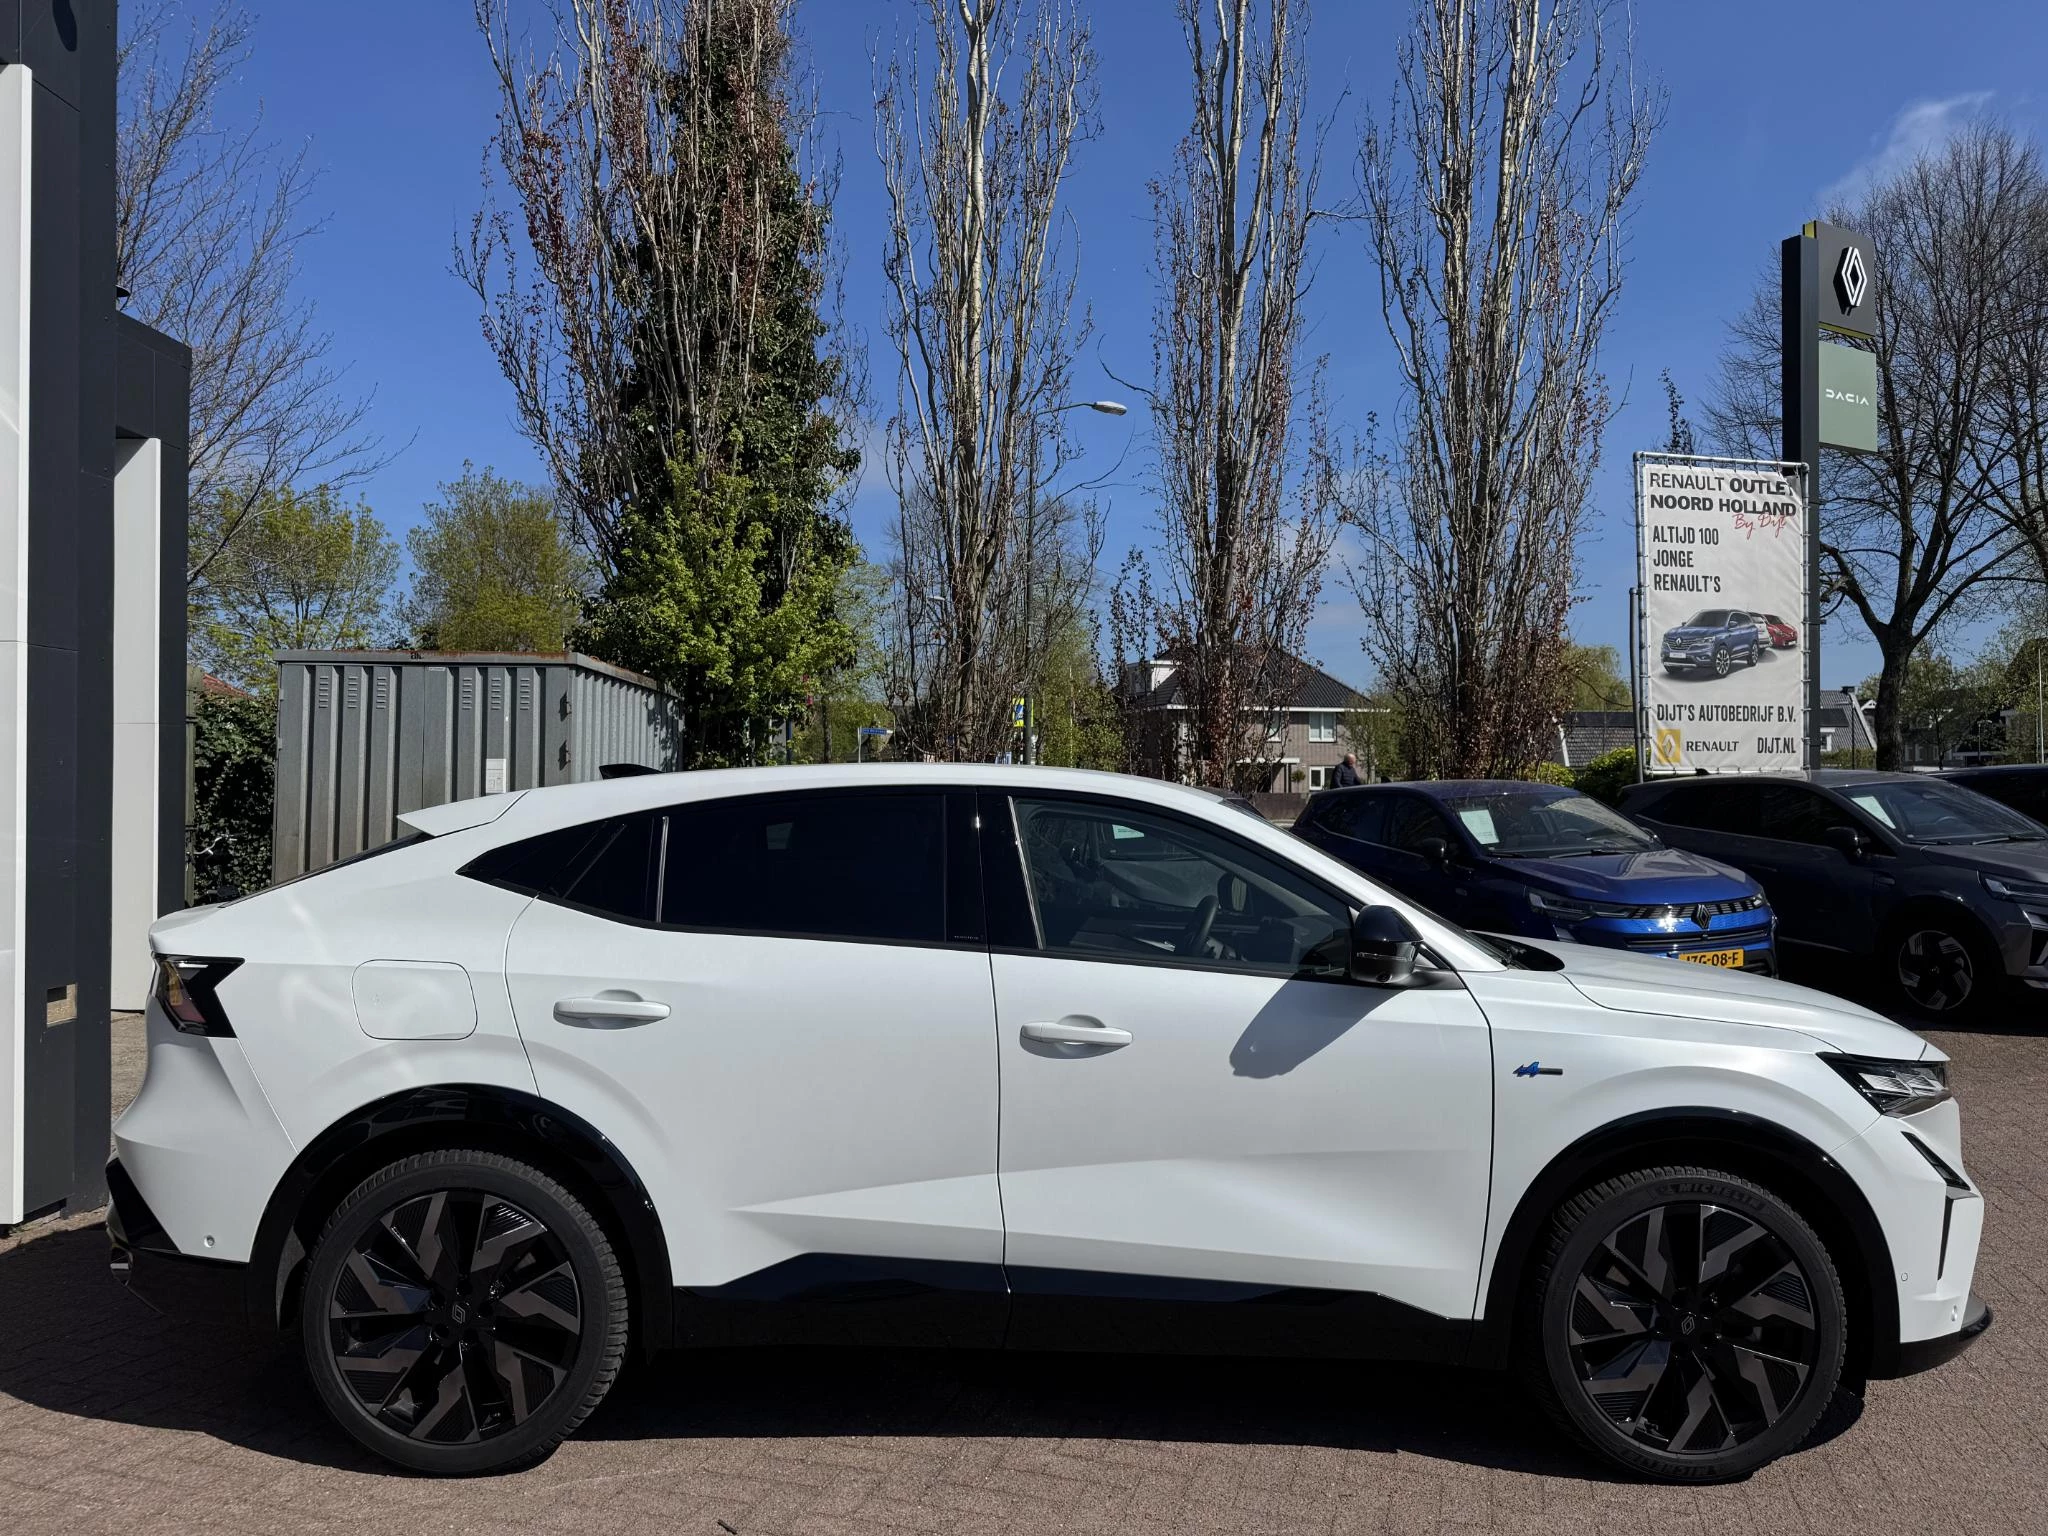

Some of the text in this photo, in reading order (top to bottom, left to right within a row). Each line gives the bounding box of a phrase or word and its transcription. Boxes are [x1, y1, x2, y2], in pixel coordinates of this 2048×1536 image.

[1825, 388, 1869, 406] DACIA
[1650, 472, 1724, 491] RENAULT
[1650, 494, 1797, 516] NOORD HOLLAND
[1653, 525, 1719, 546] ALTIJD 100
[1732, 513, 1755, 539] By
[1653, 549, 1694, 568] JONGE
[1653, 573, 1721, 593] RENAULT'S
[1656, 703, 1796, 722] DIJT'S AUTOBEDRIJF B.V.
[1686, 740, 1739, 752] RENAULT
[1757, 737, 1796, 754] DIJT.NL
